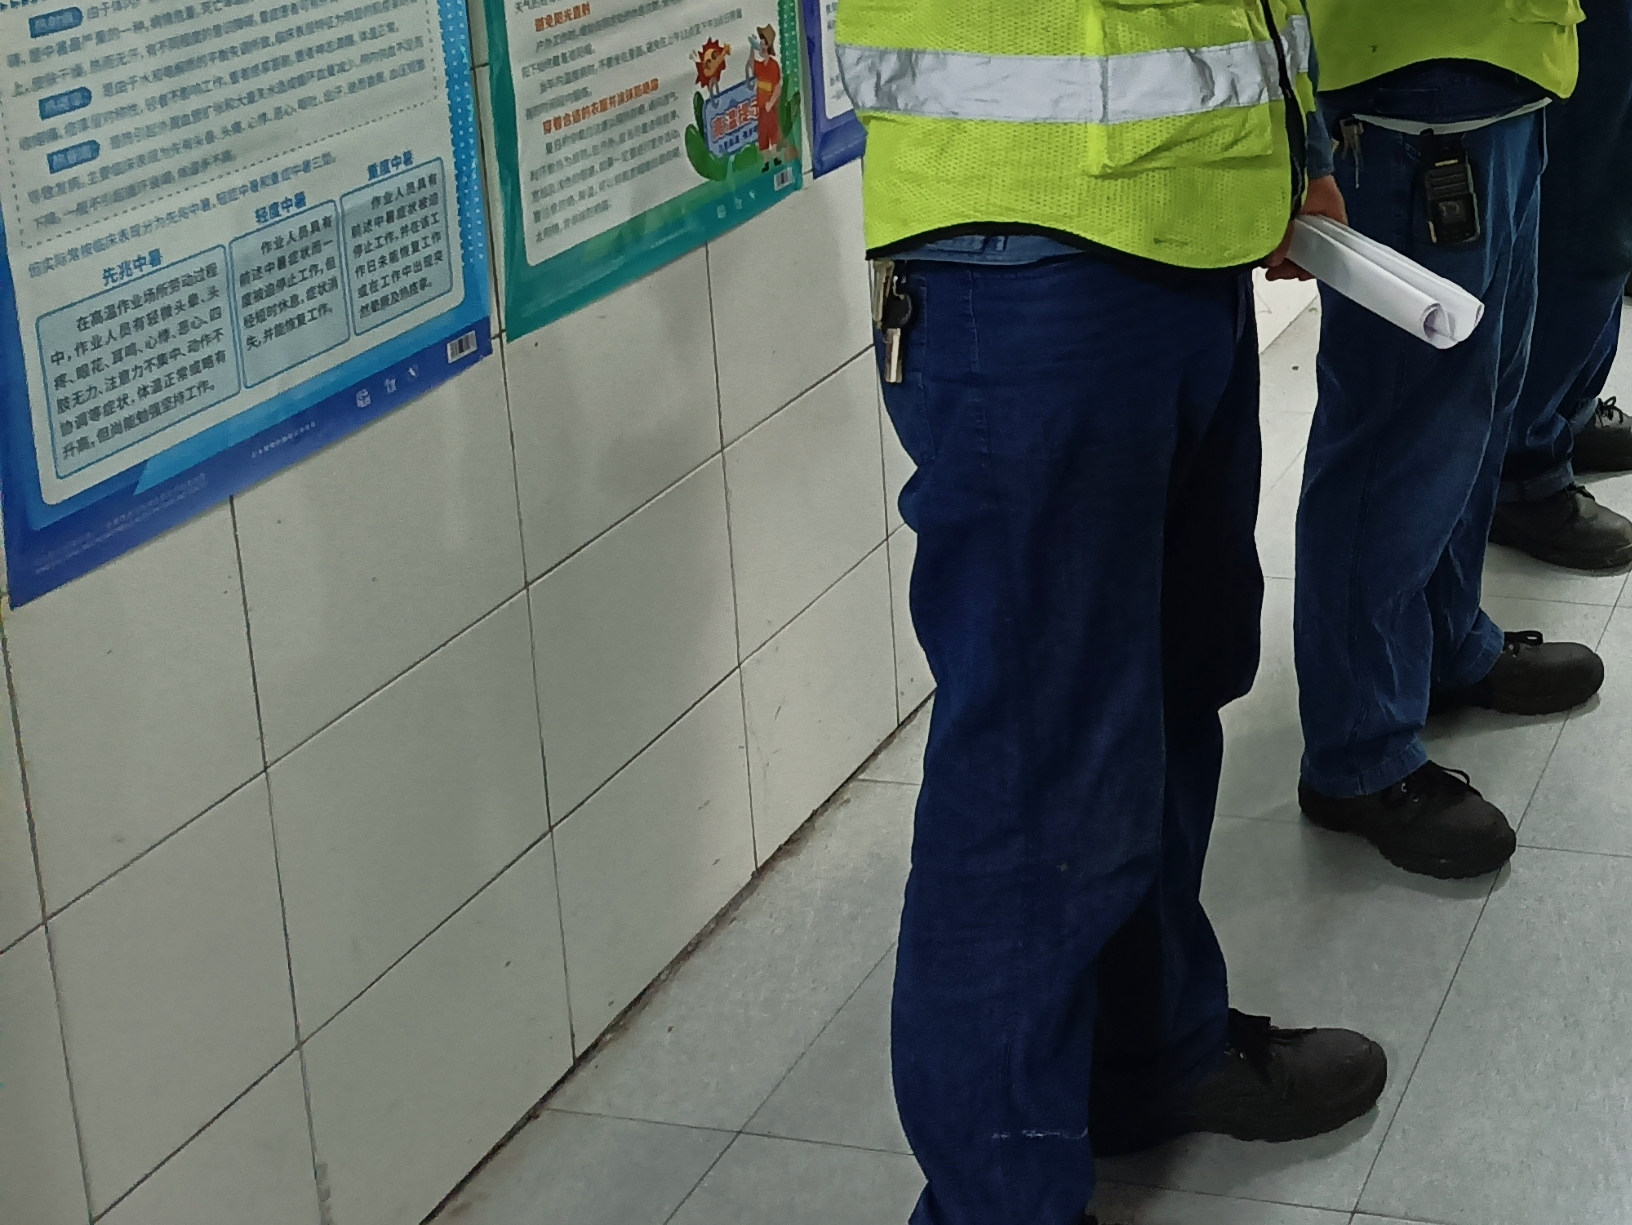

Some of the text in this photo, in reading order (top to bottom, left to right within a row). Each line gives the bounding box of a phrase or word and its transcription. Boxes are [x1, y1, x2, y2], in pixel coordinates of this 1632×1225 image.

[534, 1, 591, 32] 避免阳光直射
[366, 150, 414, 181] 重度中暑
[254, 191, 307, 224] 轻度中暑
[101, 248, 162, 287] 先兆中暑
